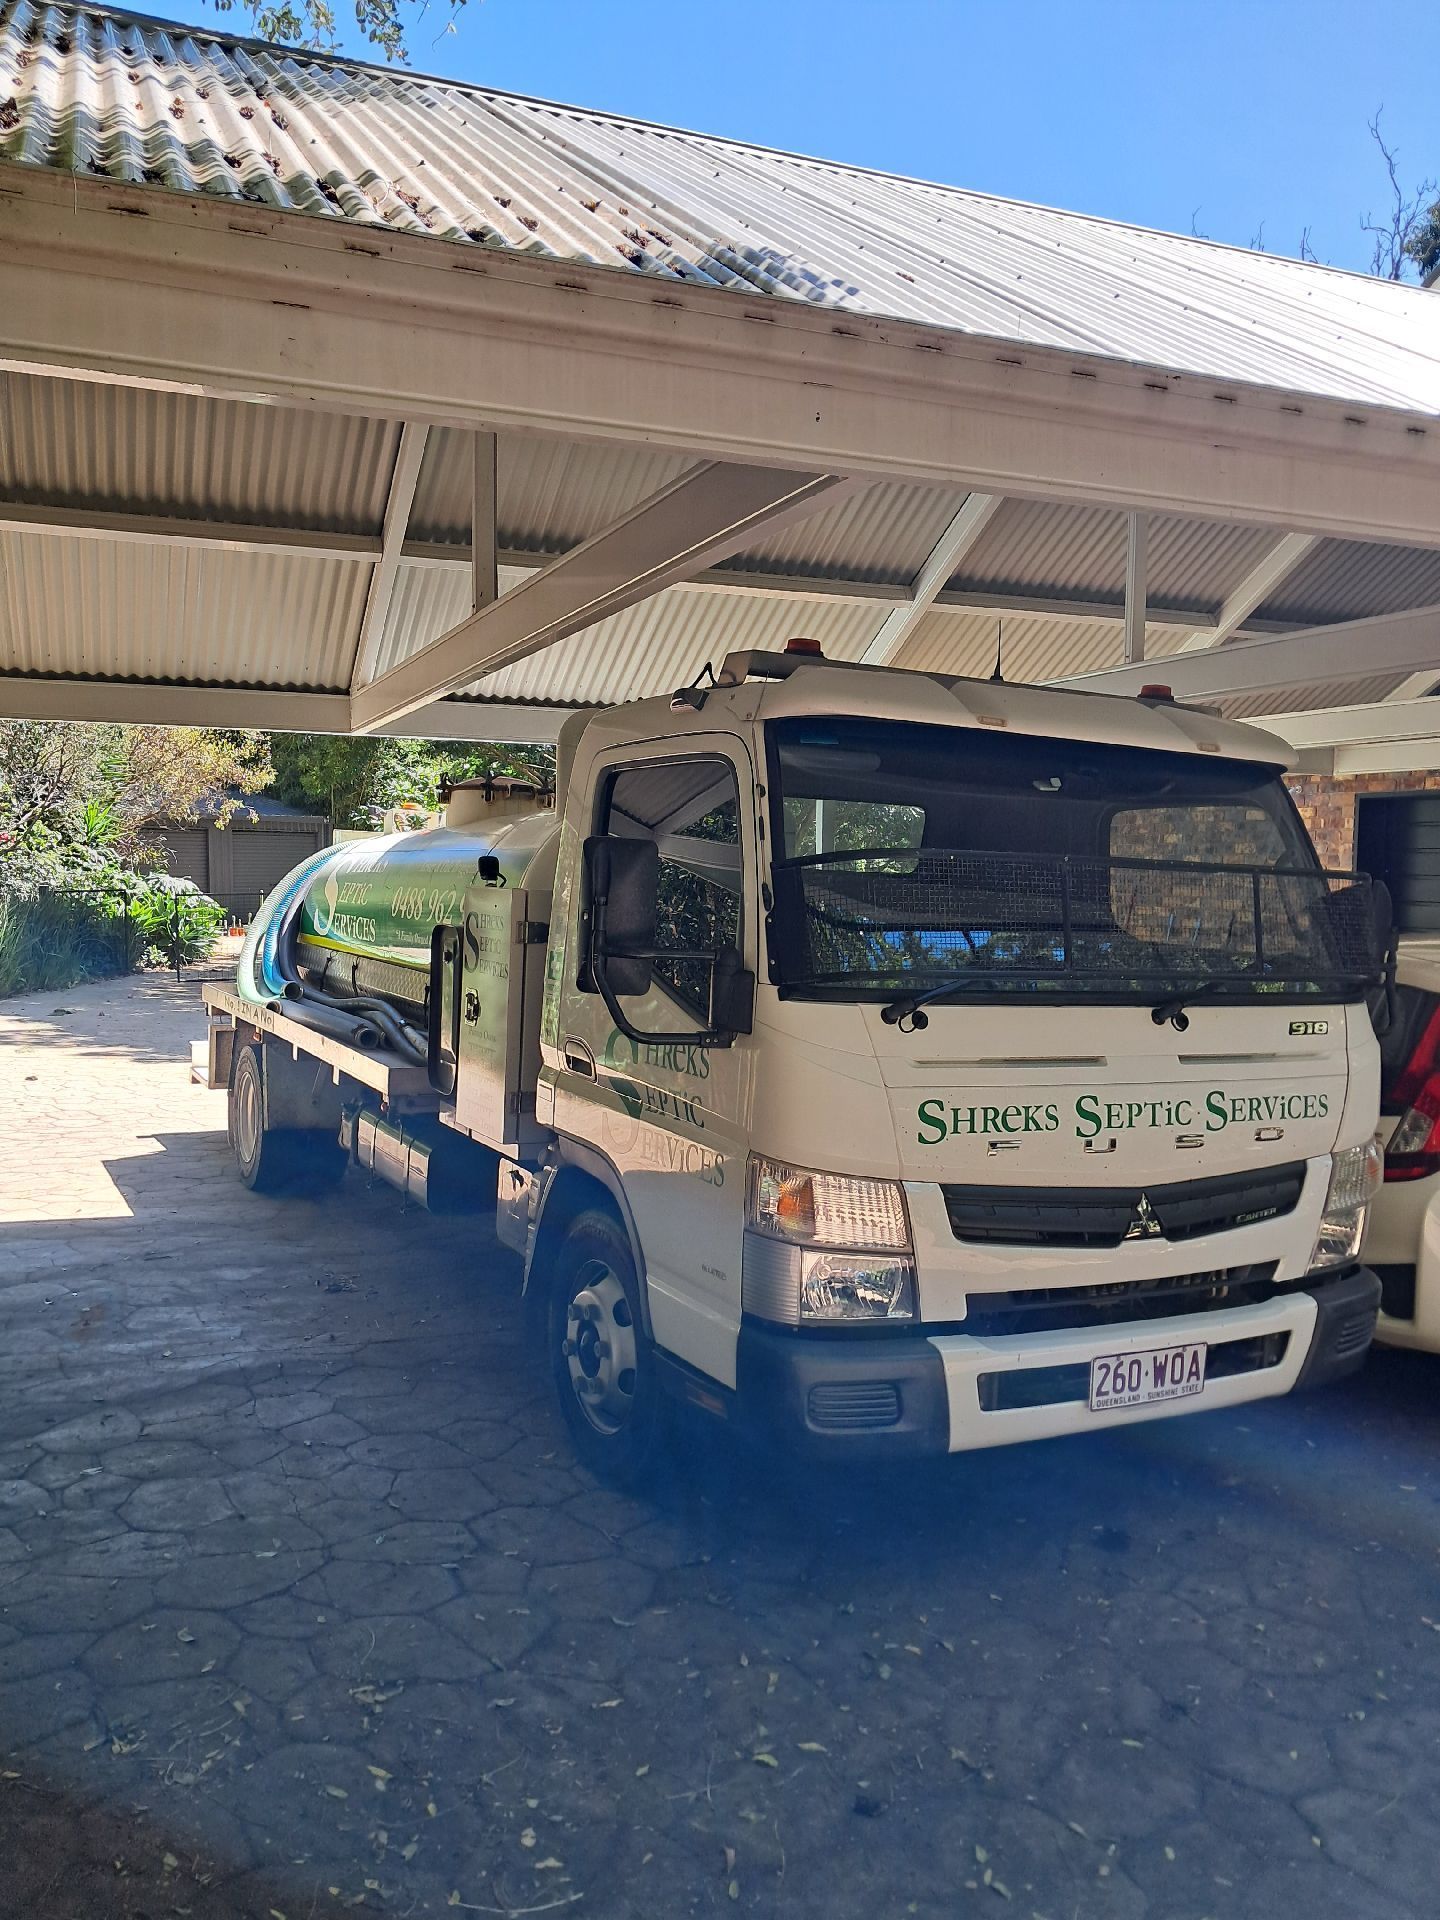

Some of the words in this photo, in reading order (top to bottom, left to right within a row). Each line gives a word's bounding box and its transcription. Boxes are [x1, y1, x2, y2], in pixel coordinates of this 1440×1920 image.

[391, 886, 425, 921] 0488
[427, 888, 456, 924] 962
[1291, 1022, 1328, 1034] 918
[987, 1126, 1284, 1157] FUSO
[1097, 1396, 1141, 1408] QUEENSLAND
[1148, 1388, 1178, 1400] SUNSHINE
[1181, 1383, 1200, 1394] STATE
